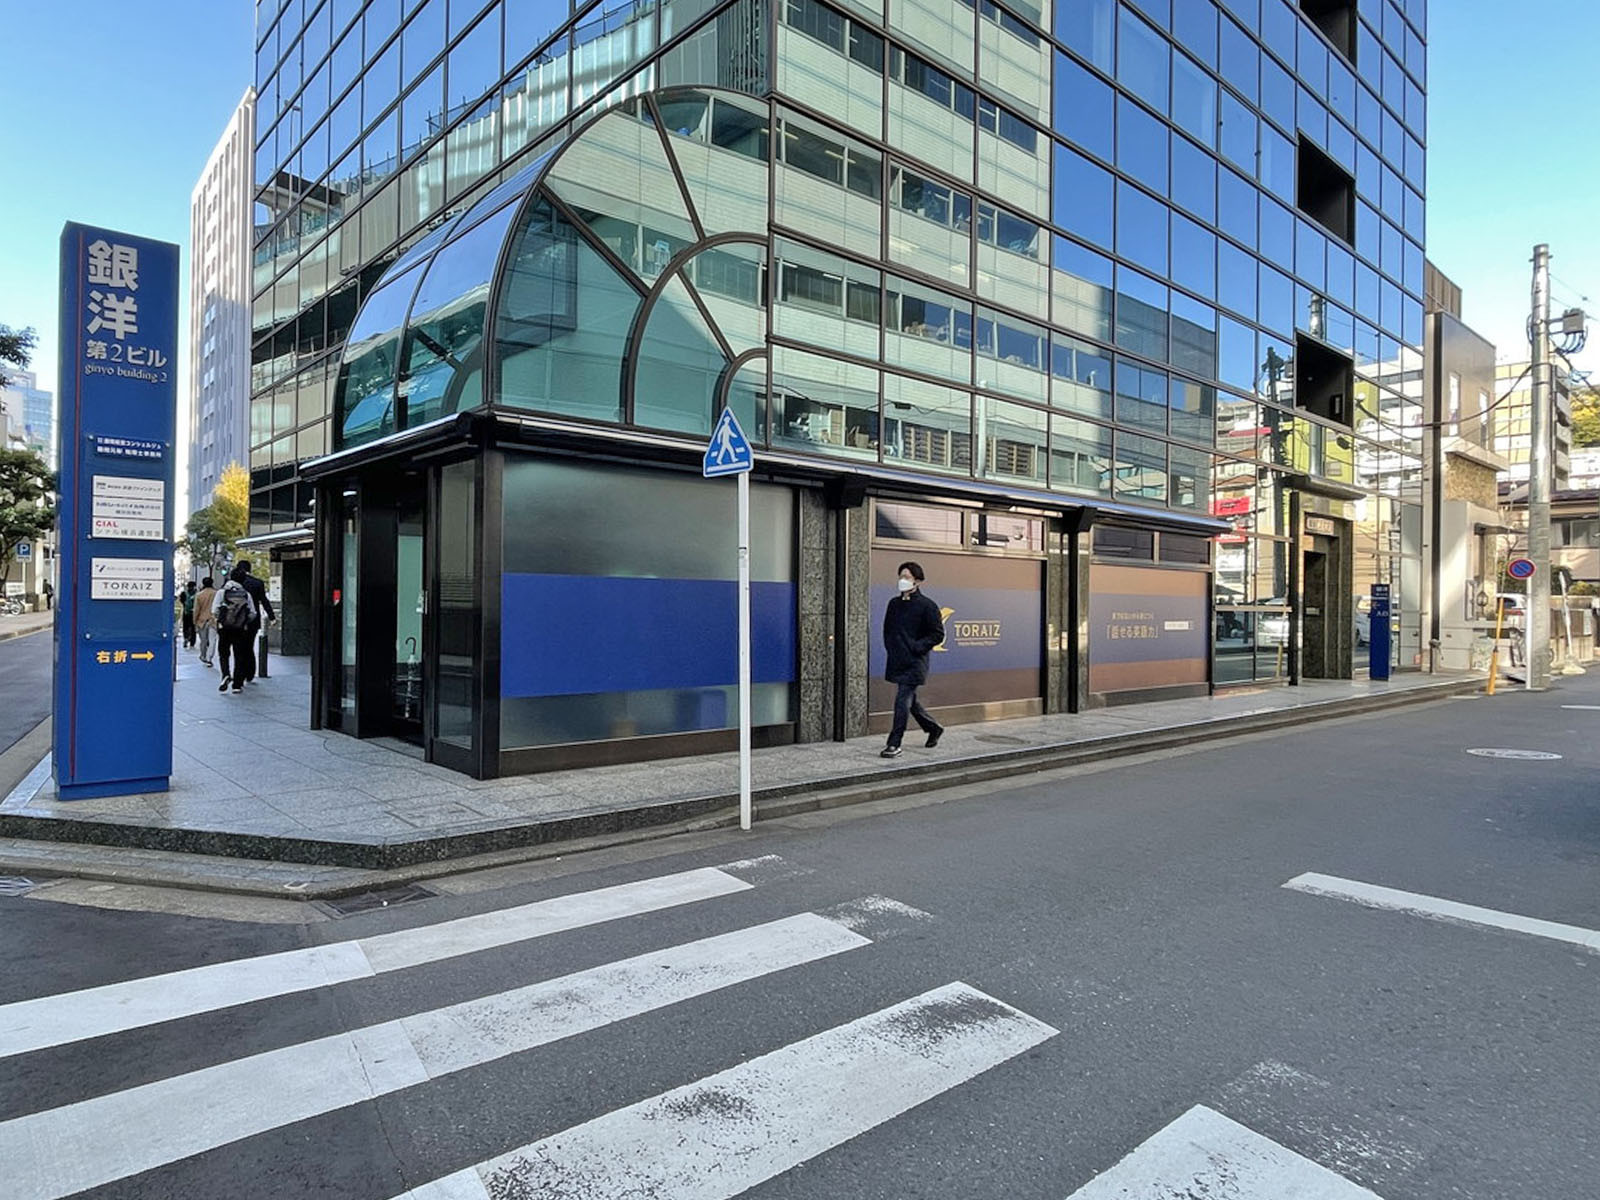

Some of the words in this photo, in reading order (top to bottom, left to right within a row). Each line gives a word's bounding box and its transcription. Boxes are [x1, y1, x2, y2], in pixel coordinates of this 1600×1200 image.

[87, 239, 139, 340] 銀洋
[86, 339, 168, 368] 第2ビル
[84, 363, 115, 376] ginyo
[117, 366, 159, 384] building
[160, 371, 168, 383] 2
[95, 520, 119, 528] CIAL
[102, 582, 153, 590] TORAIZ
[954, 624, 1001, 637] TORAIZ
[96, 650, 127, 664] 右折
